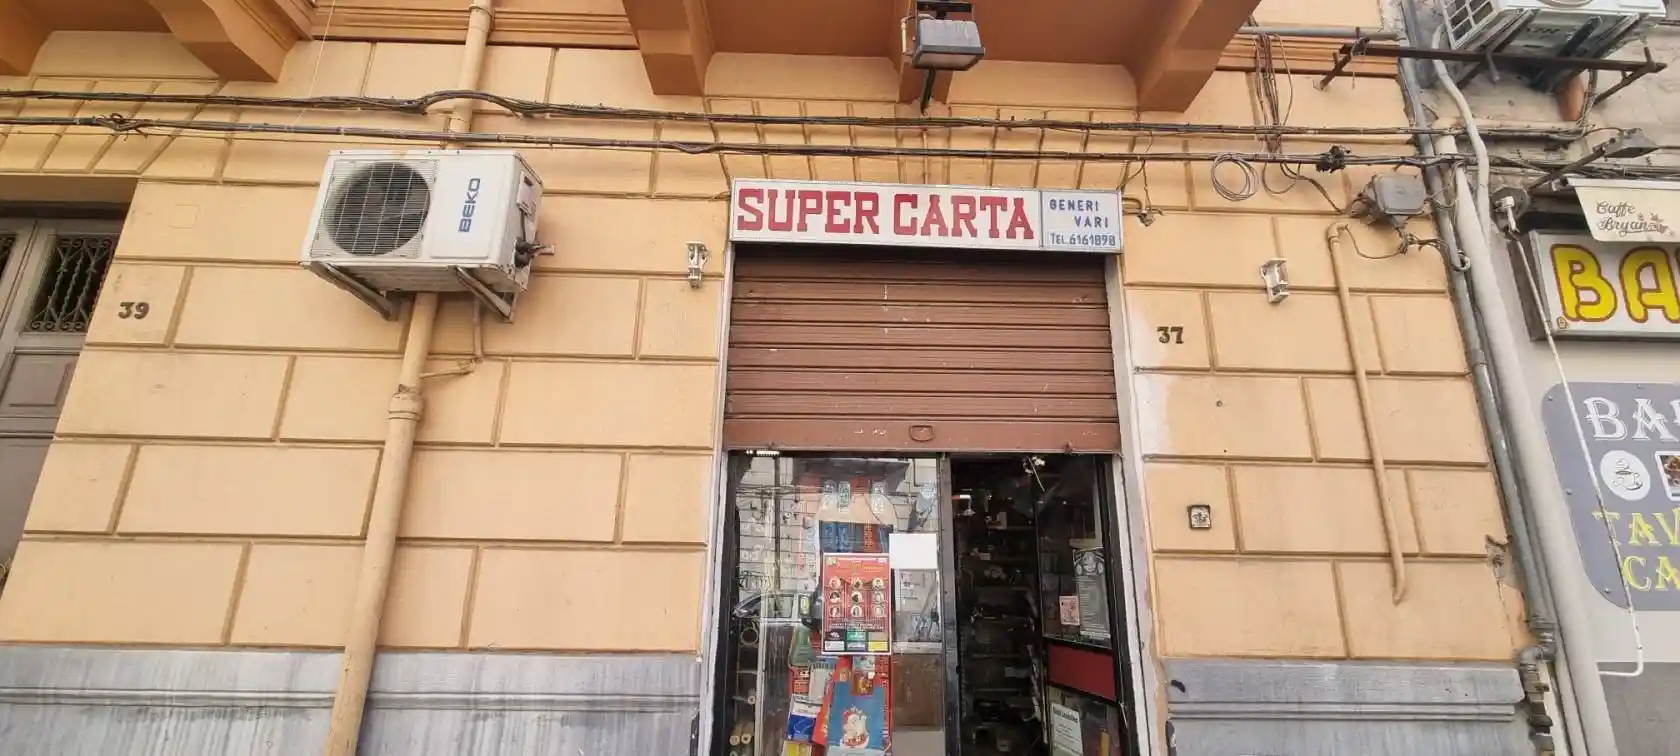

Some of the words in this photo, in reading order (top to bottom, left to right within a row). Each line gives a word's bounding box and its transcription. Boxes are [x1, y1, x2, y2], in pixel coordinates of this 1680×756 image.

[458, 178, 481, 233] BEKO
[737, 188, 880, 235] SUPER
[893, 193, 1035, 240] CARTA
[1049, 198, 1099, 212] GENERI
[1074, 215, 1109, 229] VARI
[1596, 217, 1650, 237] Bryan
[1550, 244, 1680, 324] BA
[118, 301, 150, 320] 39
[1156, 326, 1184, 344] 37
[1583, 397, 1680, 442] BA
